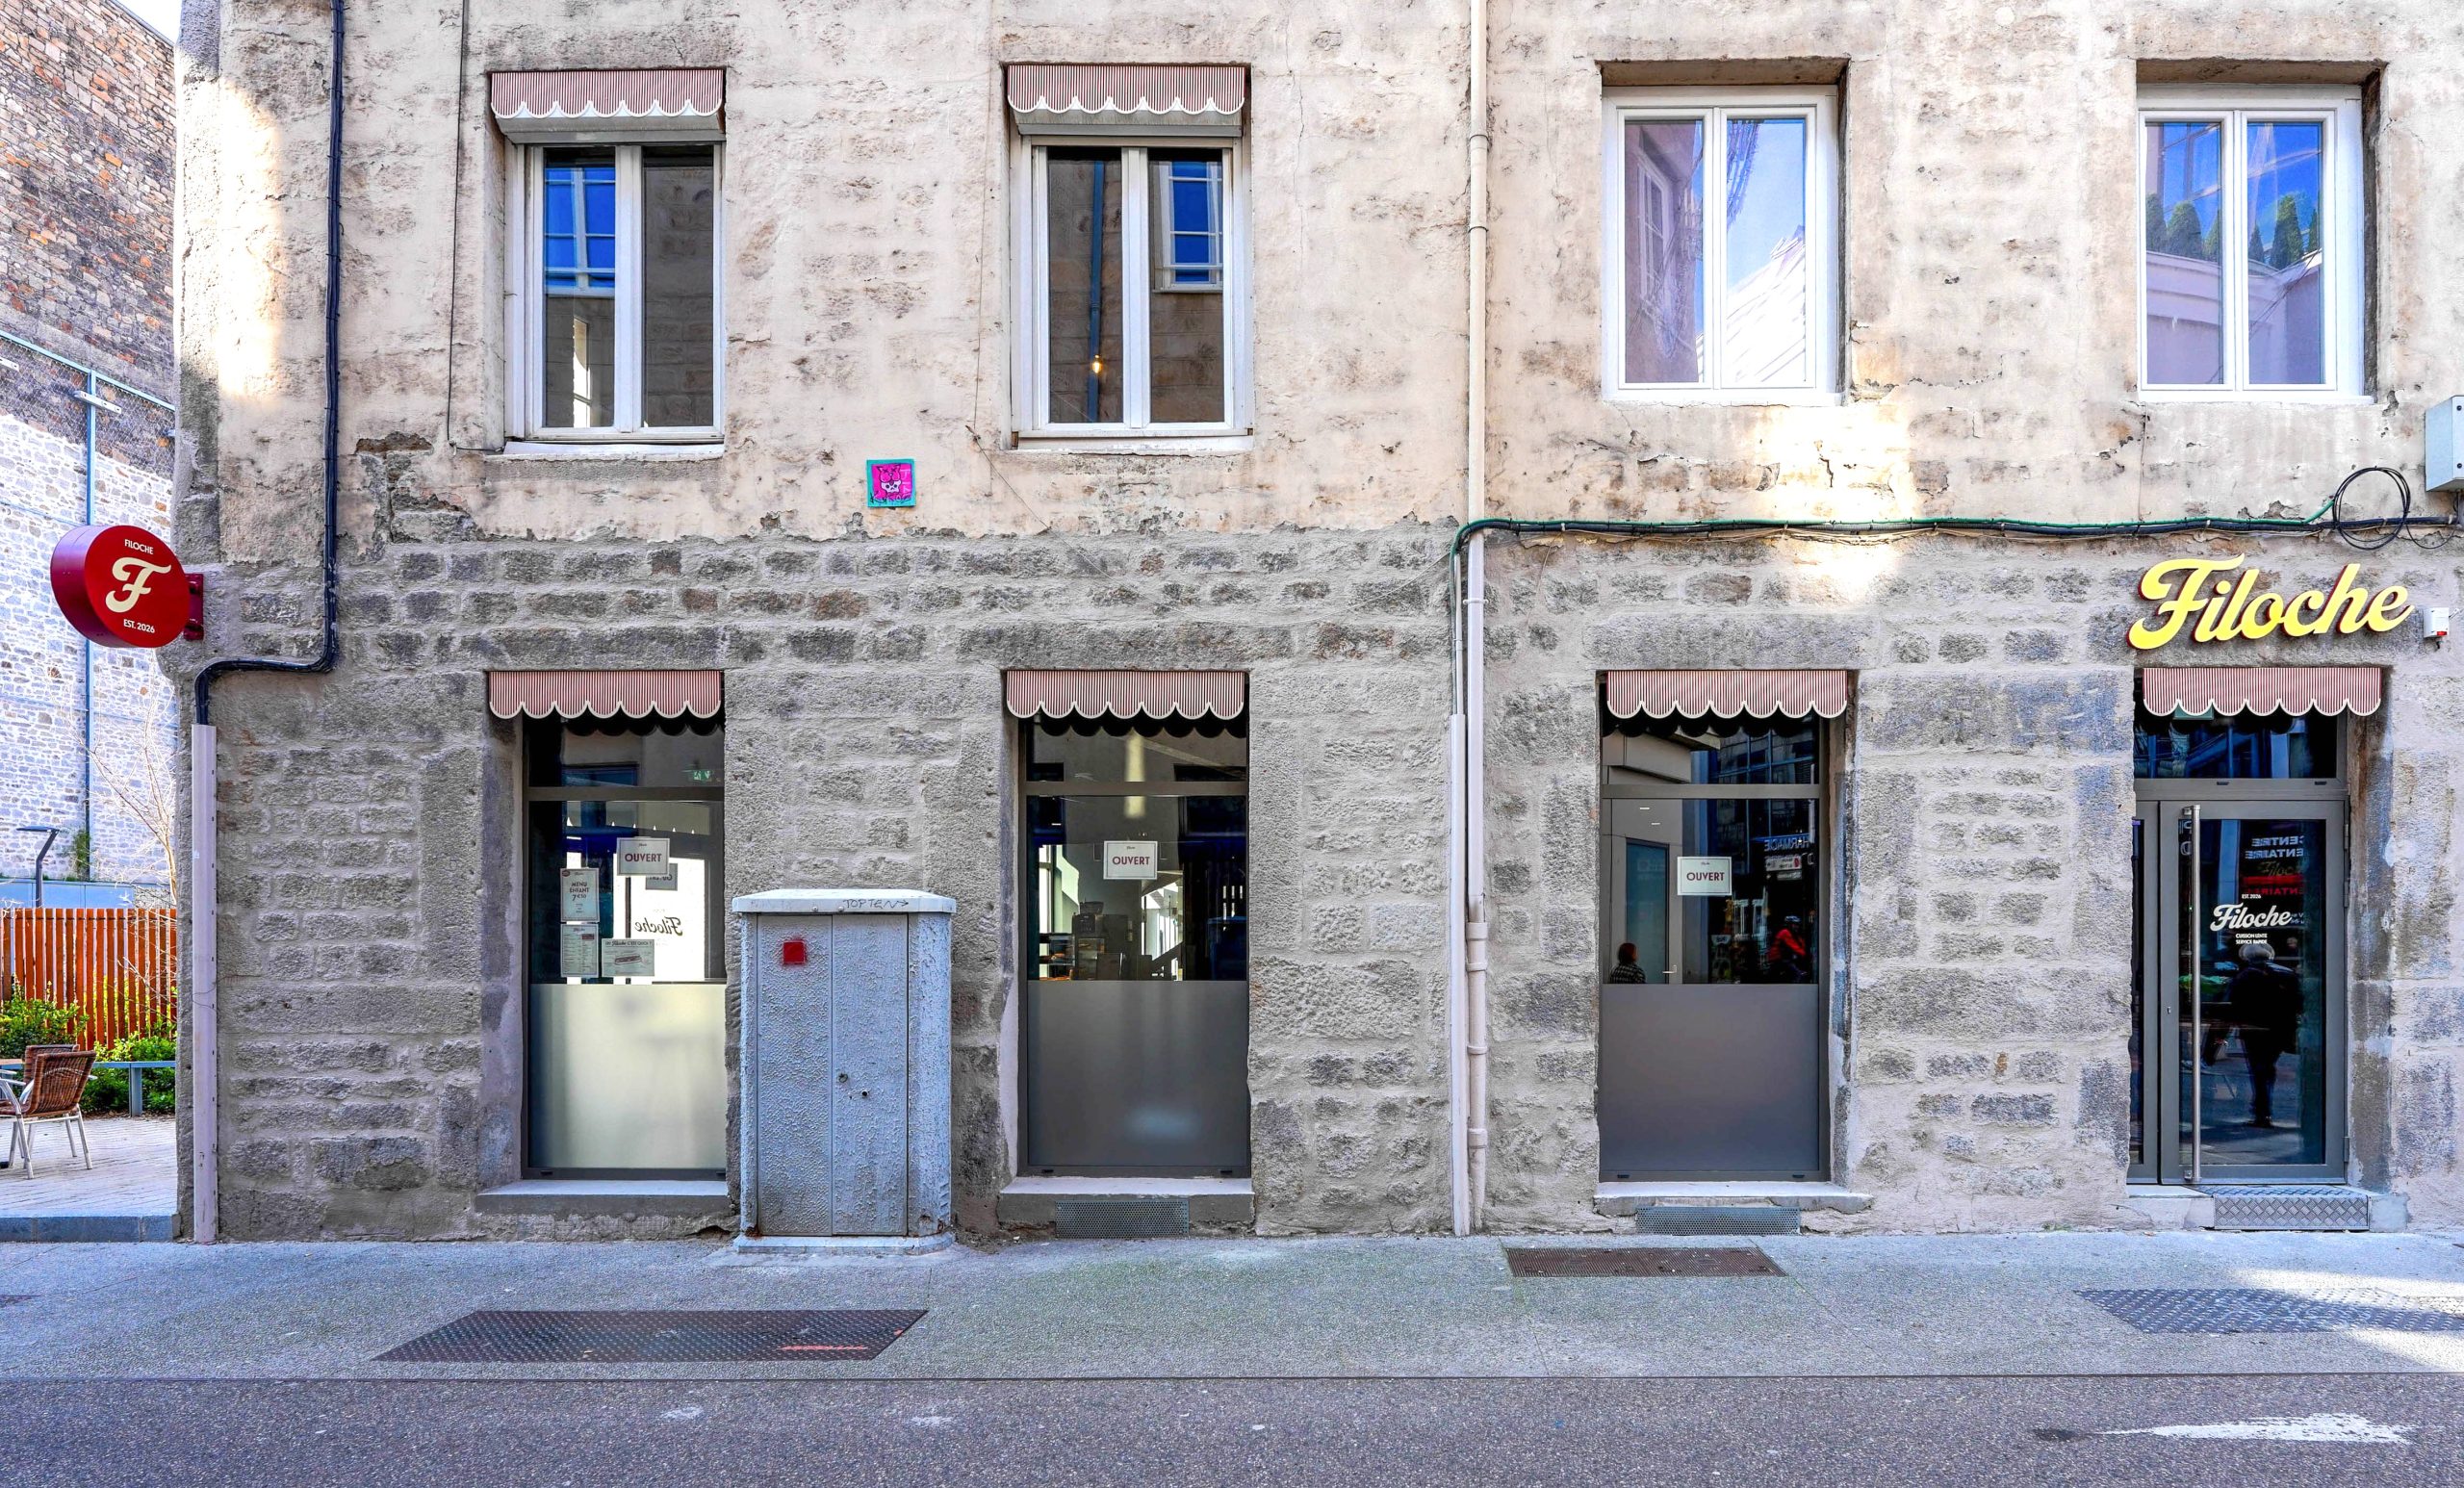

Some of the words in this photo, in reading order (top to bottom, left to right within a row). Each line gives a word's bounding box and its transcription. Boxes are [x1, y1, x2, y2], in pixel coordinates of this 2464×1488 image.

[124, 539, 154, 555] FILOCHE
[105, 556, 172, 613] F
[2126, 552, 2416, 651] Filoche
[123, 619, 137, 629] EST.
[137, 622, 155, 634] 2026
[625, 853, 662, 862] OUVERT
[1112, 856, 1150, 865] OUVERT
[1686, 872, 1725, 882] OUVERT
[843, 898, 866, 909] TOP
[2210, 902, 2293, 932] Filoche
